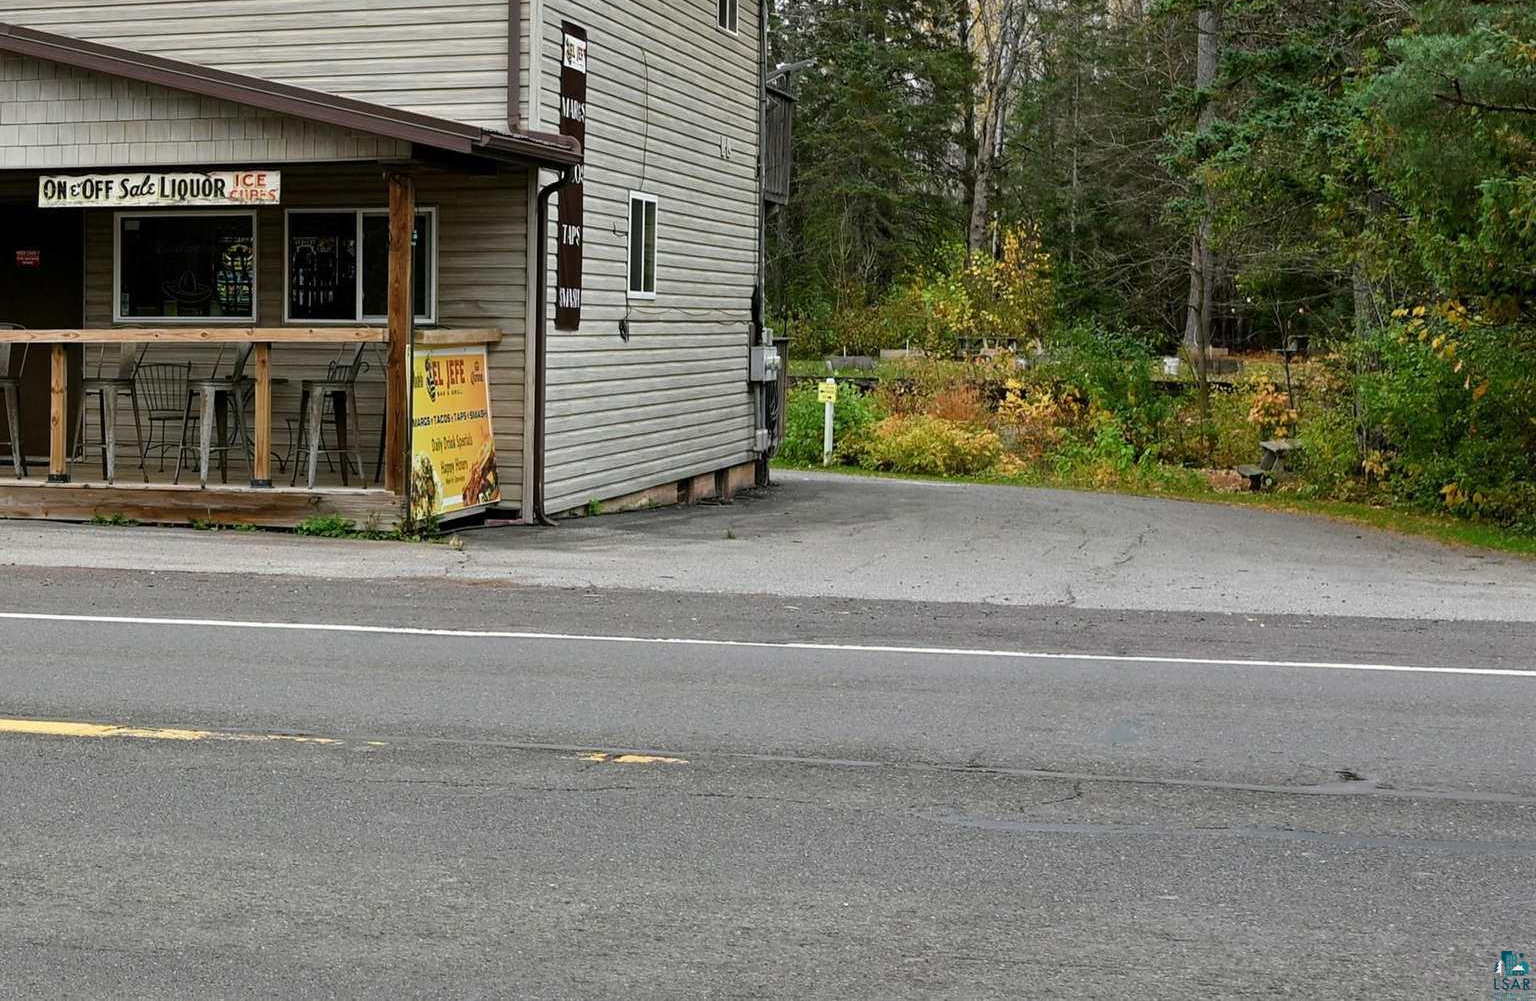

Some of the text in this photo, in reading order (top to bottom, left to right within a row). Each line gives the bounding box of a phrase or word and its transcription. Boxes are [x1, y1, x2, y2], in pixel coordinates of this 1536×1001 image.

[43, 179, 67, 199] ON
[82, 178, 114, 199] OFF
[119, 175, 156, 199] Sale
[160, 176, 226, 201] LIQUOR
[235, 174, 267, 187] ICE
[562, 224, 580, 247] TAPS
[432, 361, 443, 386] EL
[446, 359, 465, 390] JEFE
